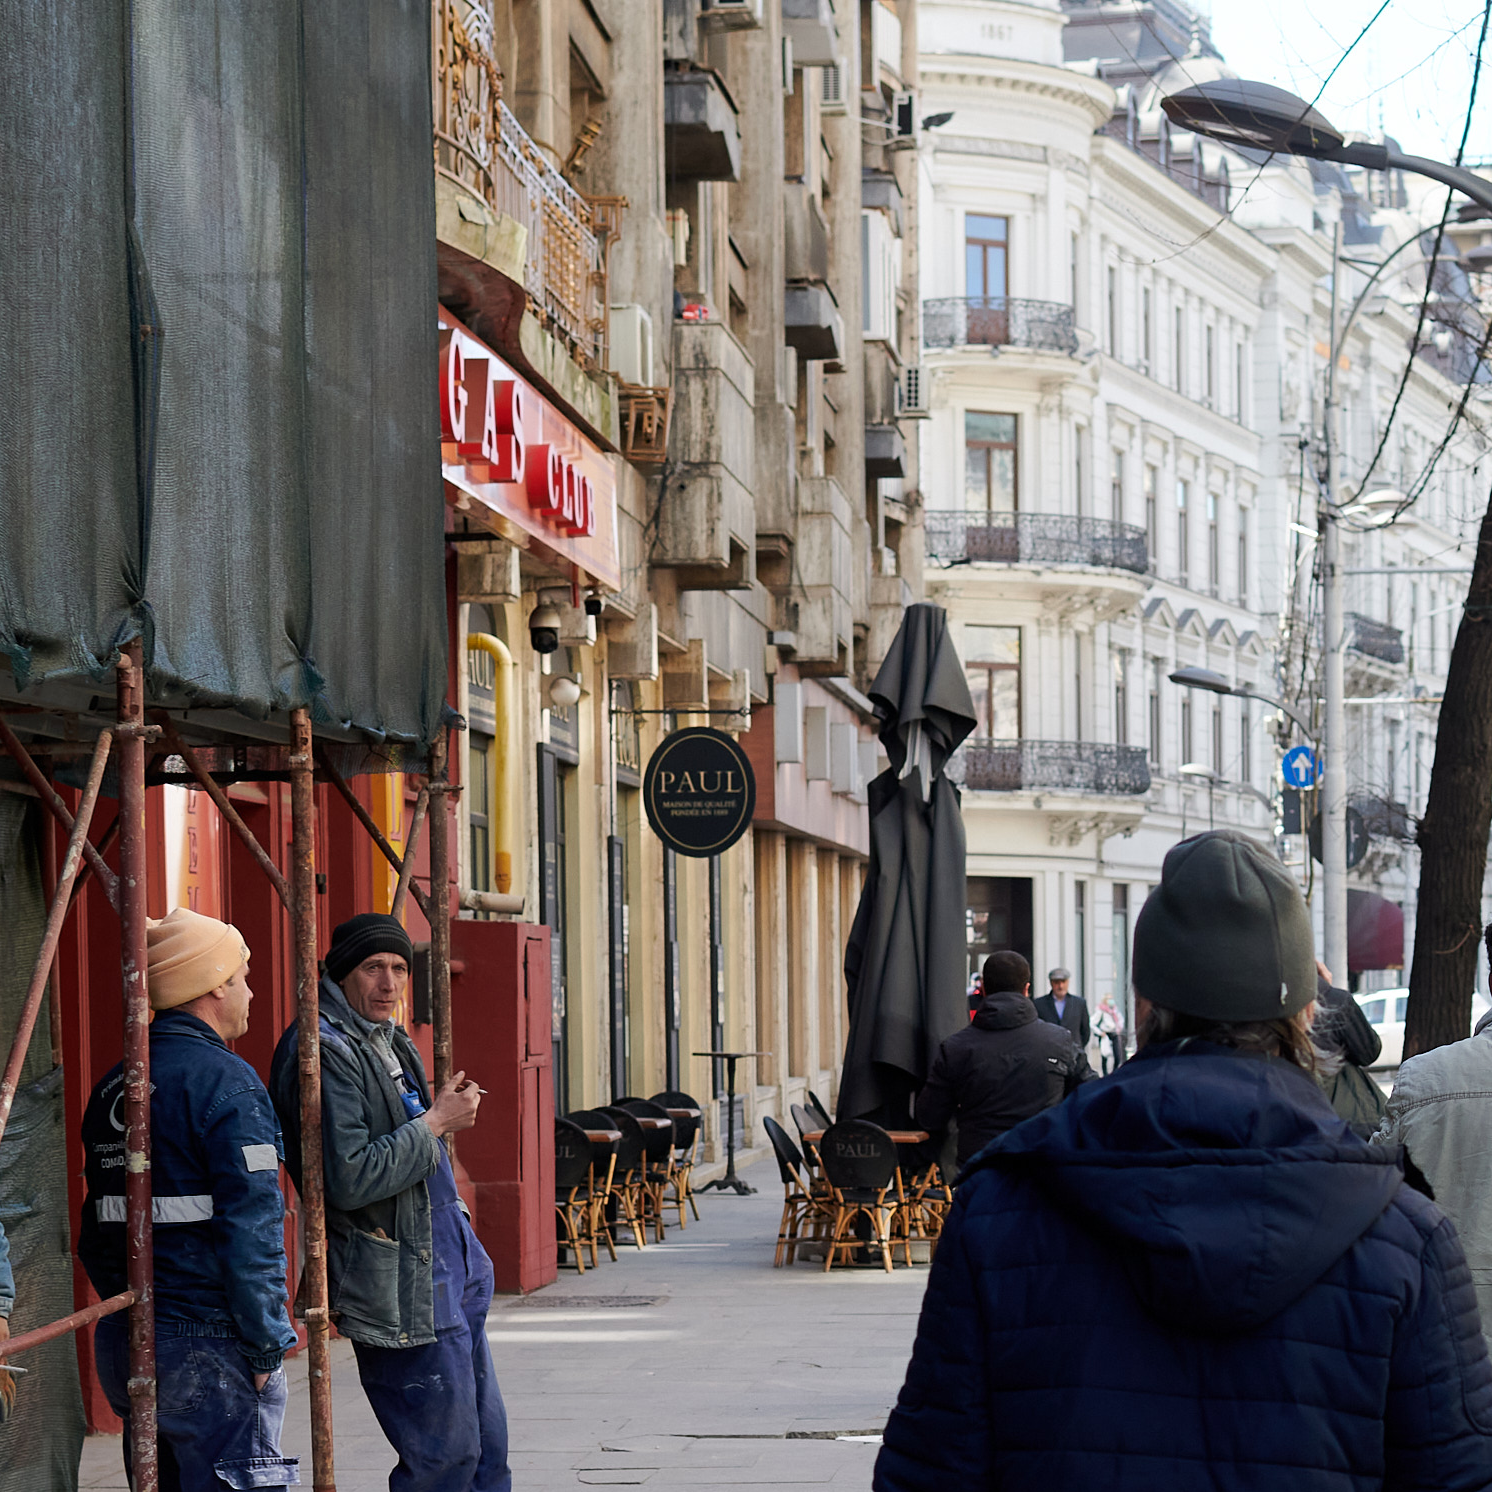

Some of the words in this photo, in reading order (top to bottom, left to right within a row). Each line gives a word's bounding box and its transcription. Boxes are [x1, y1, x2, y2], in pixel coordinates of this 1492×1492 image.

[980, 23, 1014, 41] 1867
[548, 442, 596, 538] CLUB
[659, 771, 743, 793] PAUL
[836, 1143, 881, 1158] PAUL
